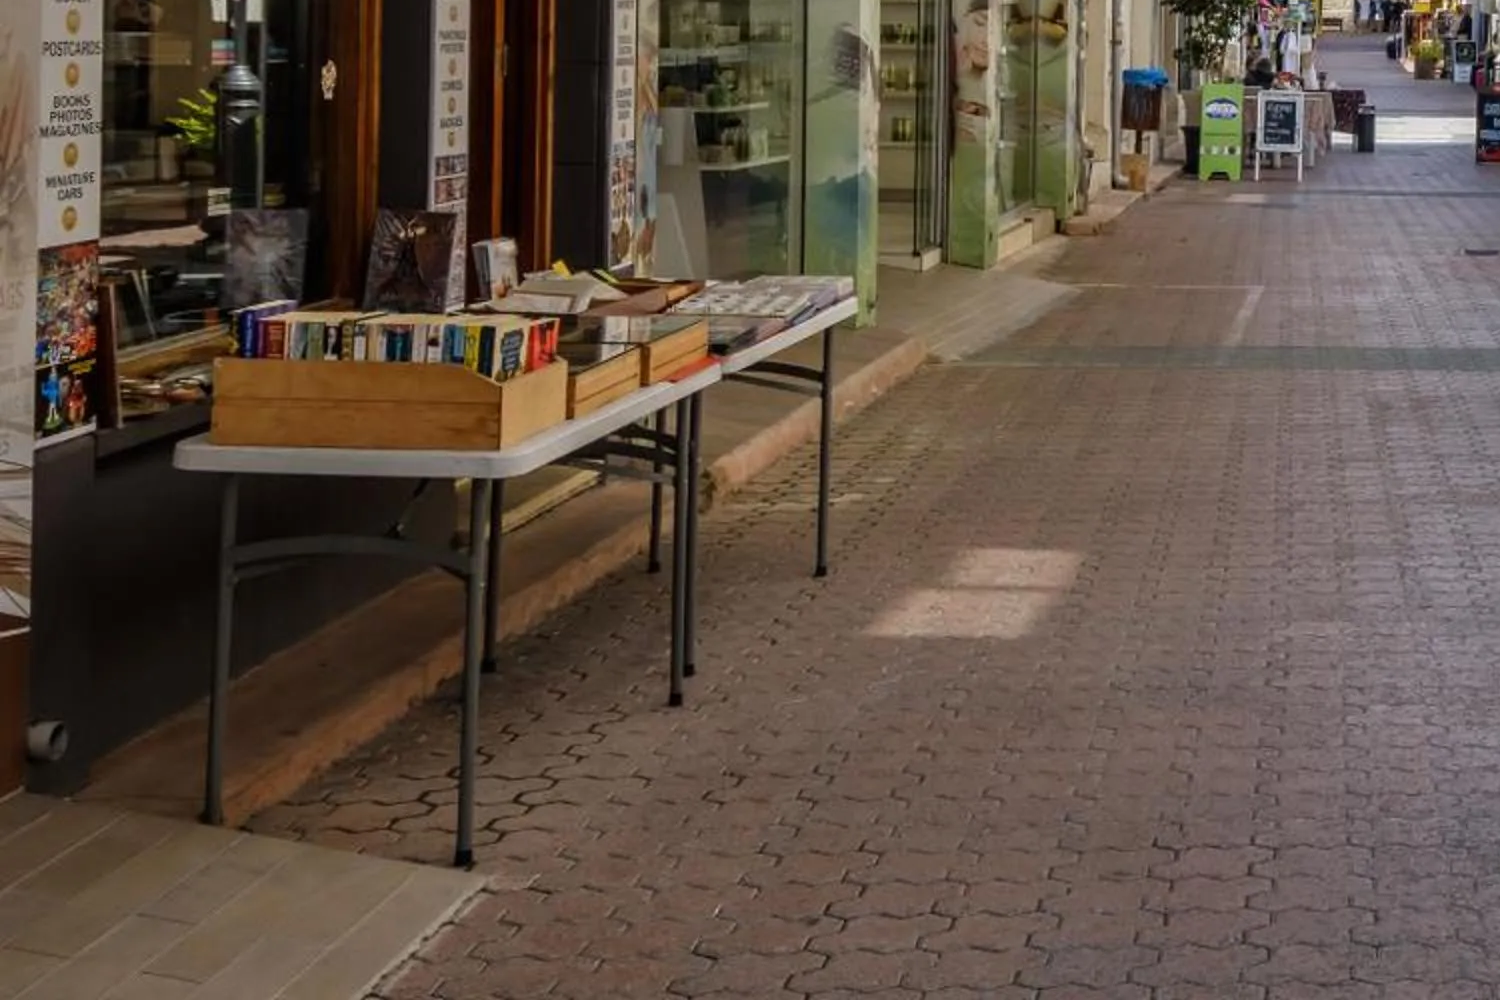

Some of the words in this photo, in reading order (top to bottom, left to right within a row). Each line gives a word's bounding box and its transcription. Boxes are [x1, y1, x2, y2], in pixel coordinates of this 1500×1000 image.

[42, 40, 102, 57] POSTCARDS
[53, 94, 91, 109] BOOKS
[49, 107, 93, 122] PHOTOS
[39, 121, 103, 138] MAGAZINES
[45, 171, 97, 188] MINIATURE
[57, 187, 84, 201] CARS
